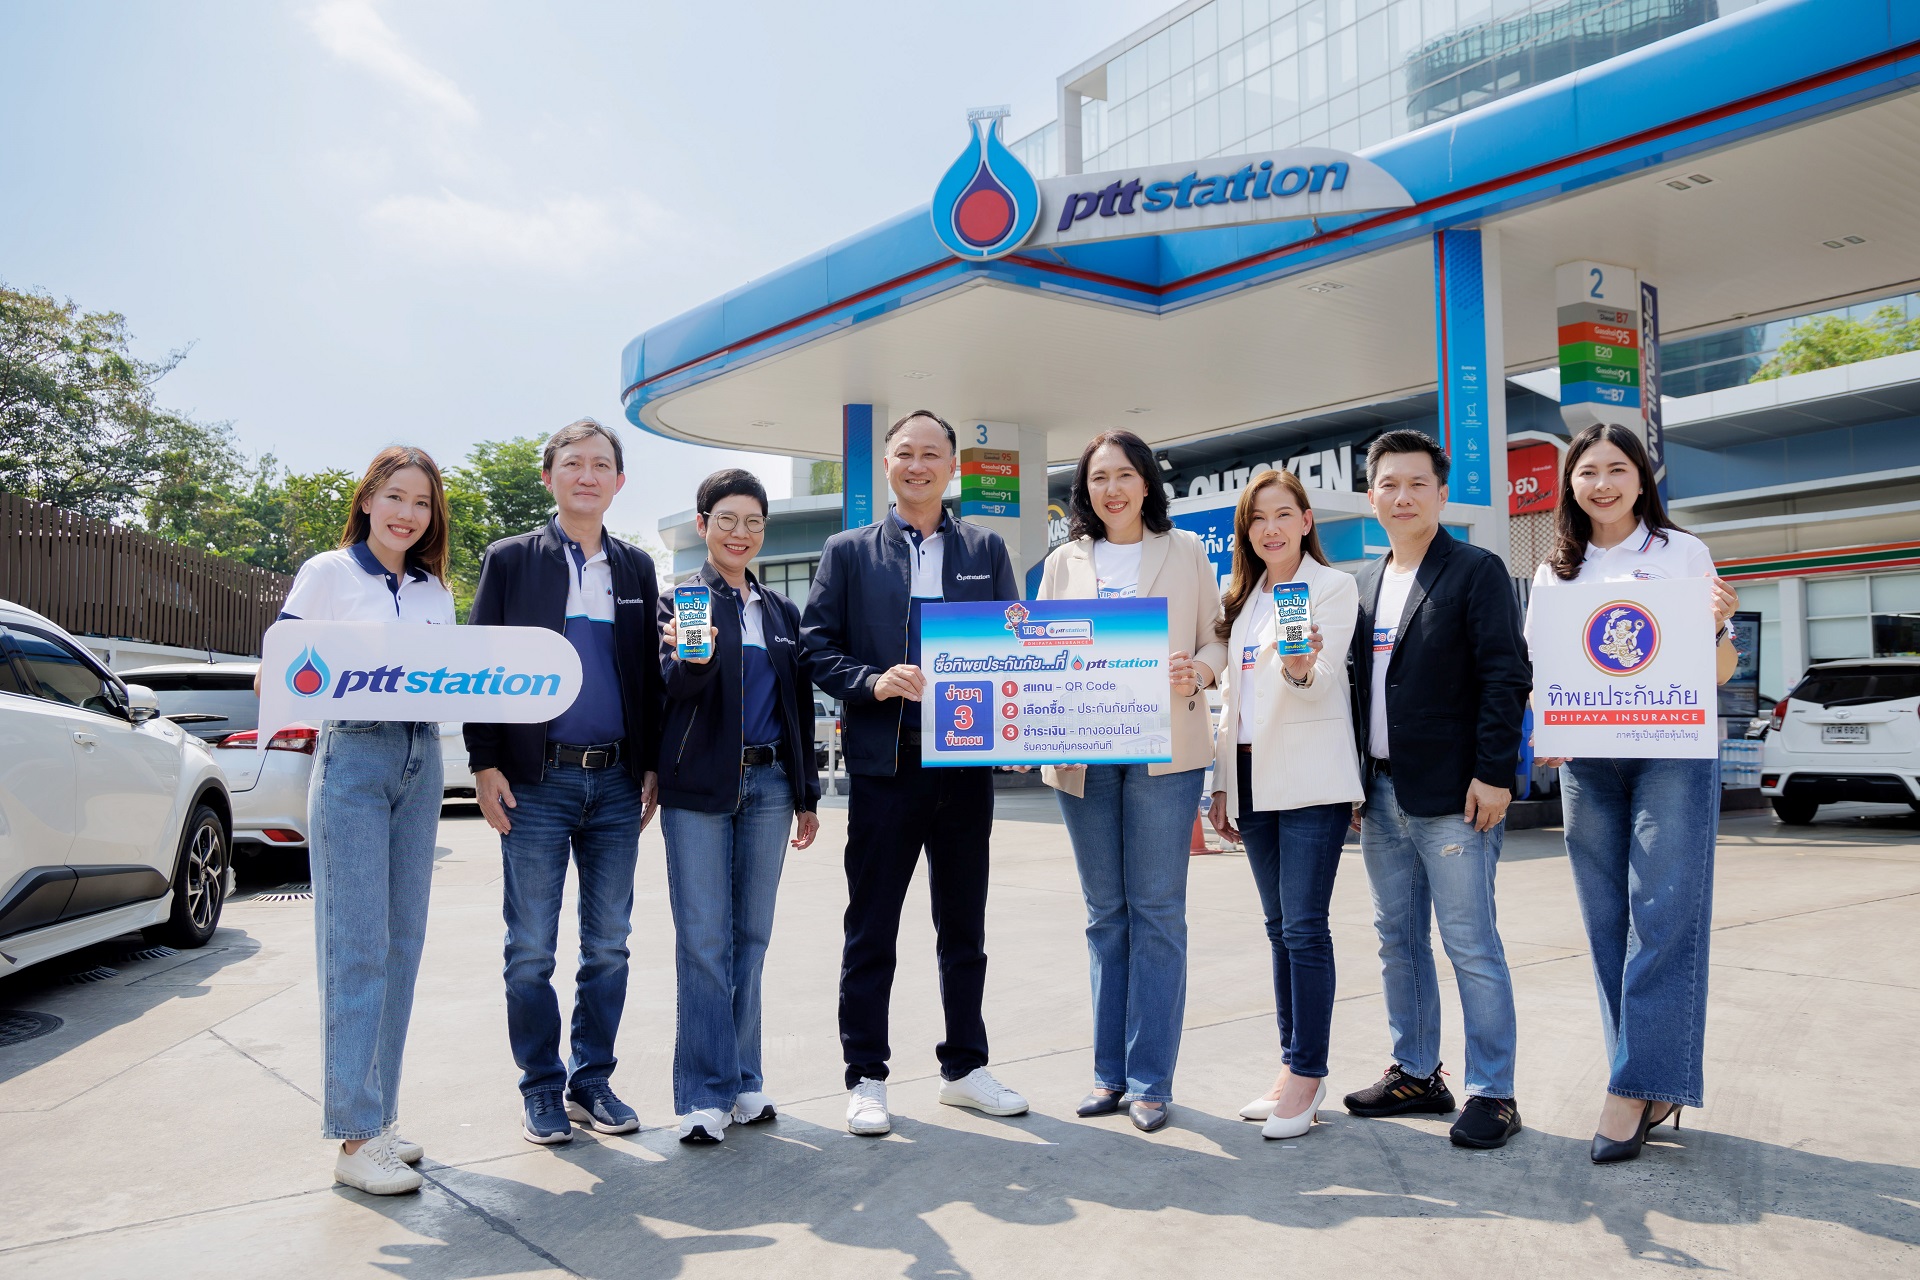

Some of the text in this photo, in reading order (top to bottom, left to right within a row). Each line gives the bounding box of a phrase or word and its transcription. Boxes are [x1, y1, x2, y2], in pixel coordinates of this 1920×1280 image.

[1590, 267, 1605, 299] 2
[1616, 312, 1628, 324] B7
[1616, 329, 1630, 345] 95
[1594, 346, 1612, 358] E20
[1618, 369, 1631, 383] 91
[1642, 288, 1659, 462] PREMIUM
[1611, 388, 1625, 402] B7
[976, 424, 988, 445] 3
[1001, 453, 1012, 461] 95
[1000, 465, 1012, 475] 95
[981, 476, 997, 486] E20
[1000, 492, 1012, 501] 91
[994, 504, 1006, 514] B7
[679, 597, 707, 611] แวะปั๊ม
[1277, 594, 1307, 608] แวะปั๊ม
[1023, 625, 1045, 636] TIP@
[945, 684, 983, 703] ง่ายๆ
[1006, 684, 1012, 694] 1
[1023, 683, 1053, 693] สแกน
[1065, 681, 1083, 691] QR
[1086, 681, 1117, 691] Code
[1547, 683, 1698, 707] ทิพยประกันภัย
[1006, 705, 1015, 716] 2
[1023, 699, 1065, 715] เลือกซื้อ
[1077, 698, 1159, 714] ประกันภัยที่ชอบ
[954, 705, 975, 730] 3
[1550, 713, 1698, 722] DHIPAYA INSURANCE
[1006, 727, 1015, 738] 3
[1023, 724, 1066, 736] ชำระเงิน
[1078, 722, 1141, 736] ทางออนไลน์
[1616, 729, 1699, 742] ภาครัฐเป็นผู้ถือหุ้นใหญ่
[945, 730, 984, 746] ขั้นตอน
[1023, 739, 1113, 754] รับความคุ้มครองทันที
